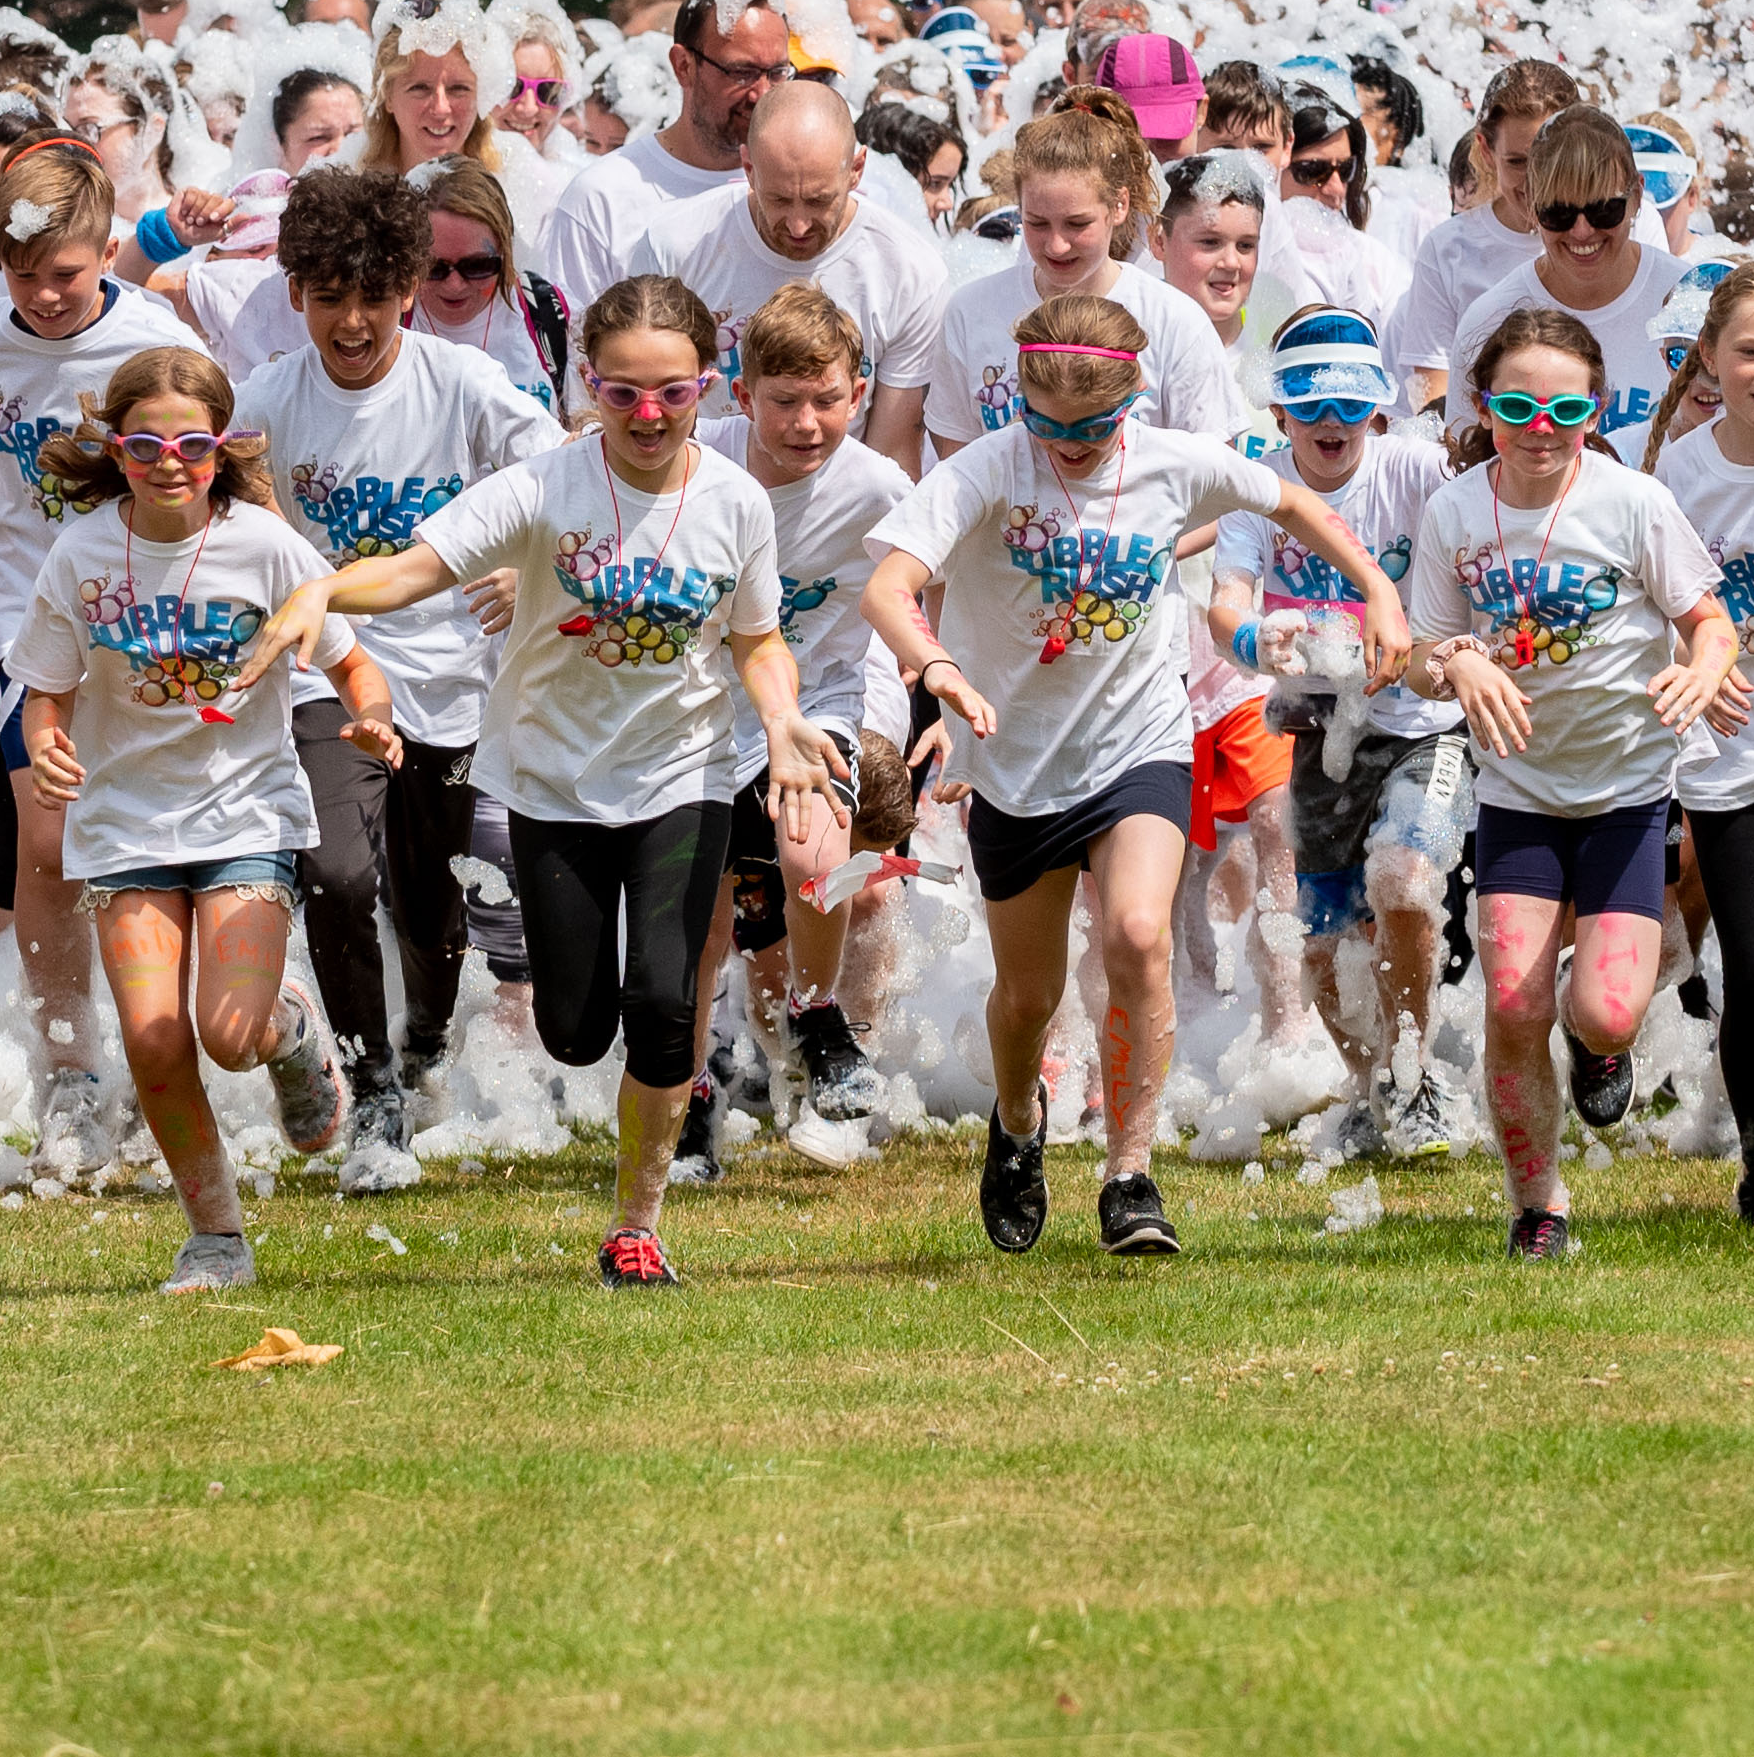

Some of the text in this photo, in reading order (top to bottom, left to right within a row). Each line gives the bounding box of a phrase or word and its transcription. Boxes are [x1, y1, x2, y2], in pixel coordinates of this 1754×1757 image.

[1008, 529, 1153, 574] BUBBLE
[553, 557, 707, 610] BUBBLE
[1040, 567, 1160, 604] RUSH
